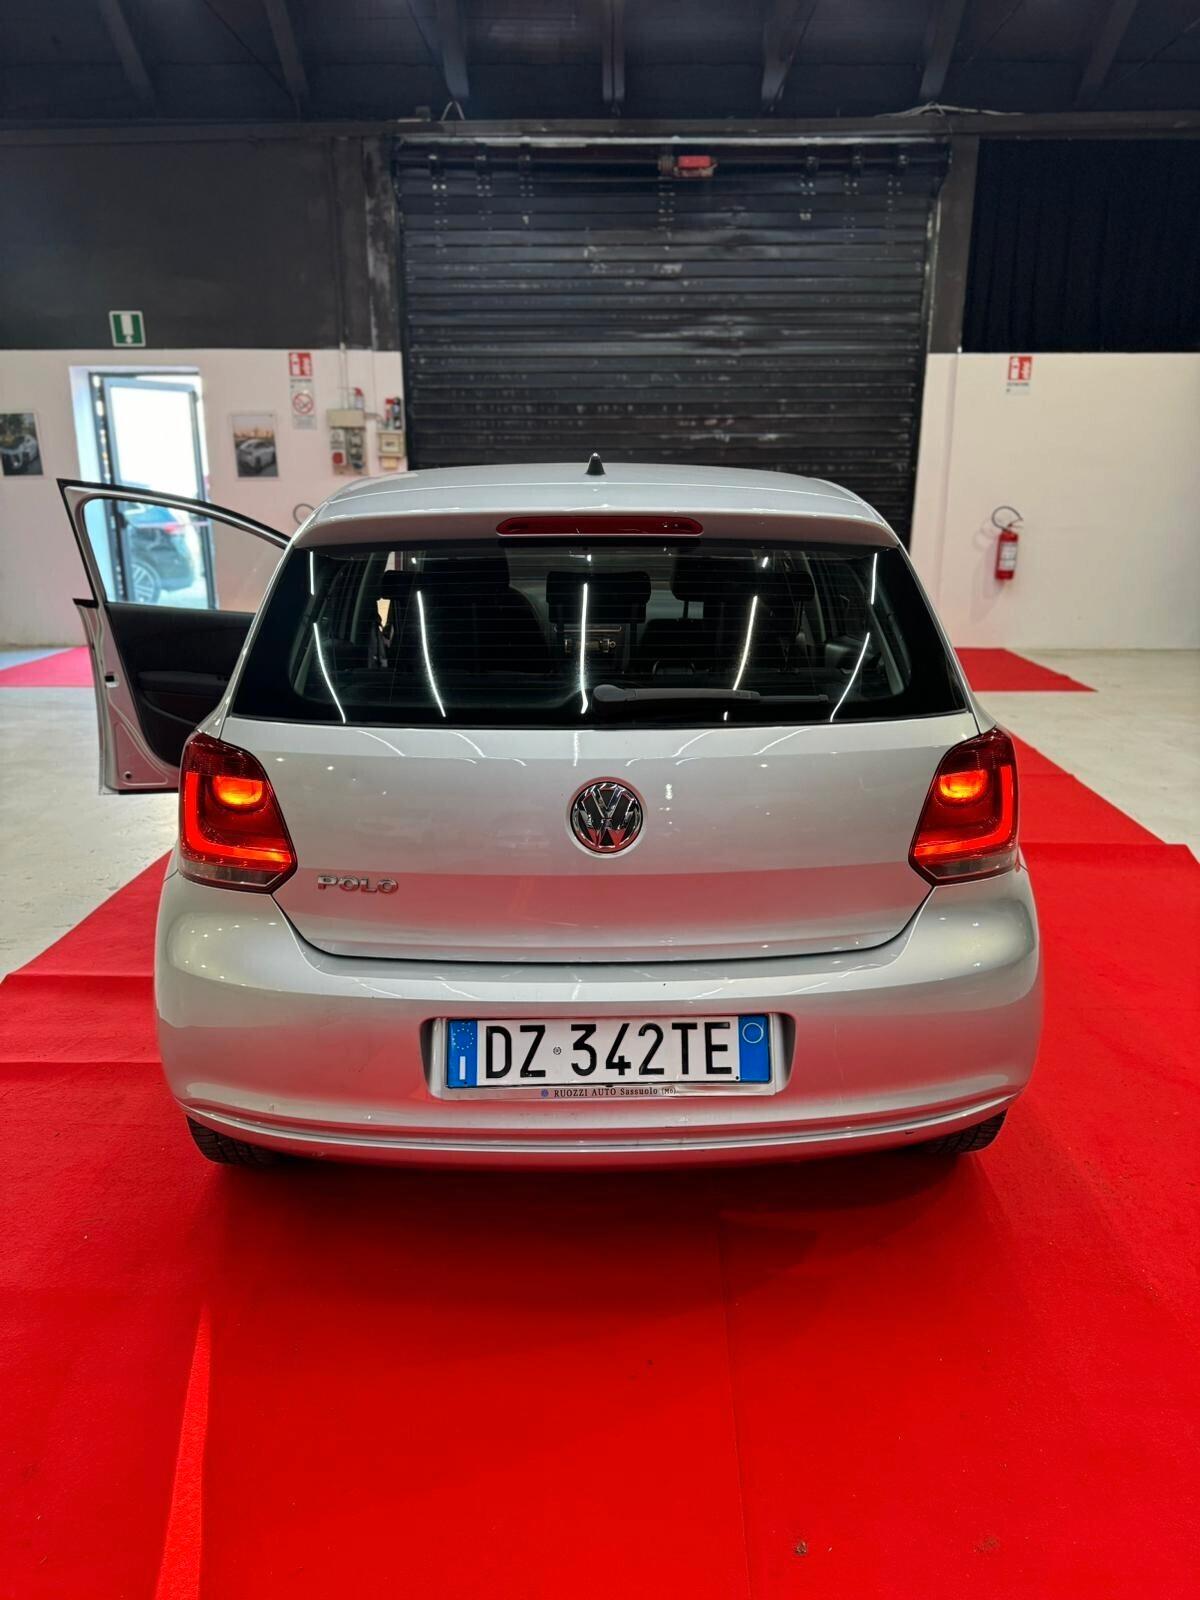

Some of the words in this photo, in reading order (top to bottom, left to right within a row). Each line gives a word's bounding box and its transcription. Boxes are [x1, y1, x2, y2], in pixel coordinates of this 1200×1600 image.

[317, 876, 399, 893] POLO
[485, 1025, 547, 1079] DZ
[570, 1022, 732, 1077] 342TE
[459, 1056, 466, 1080] I
[554, 1088, 588, 1098] RUOZZI
[591, 1088, 617, 1097] AUTO
[620, 1086, 658, 1096] Sassuolo
